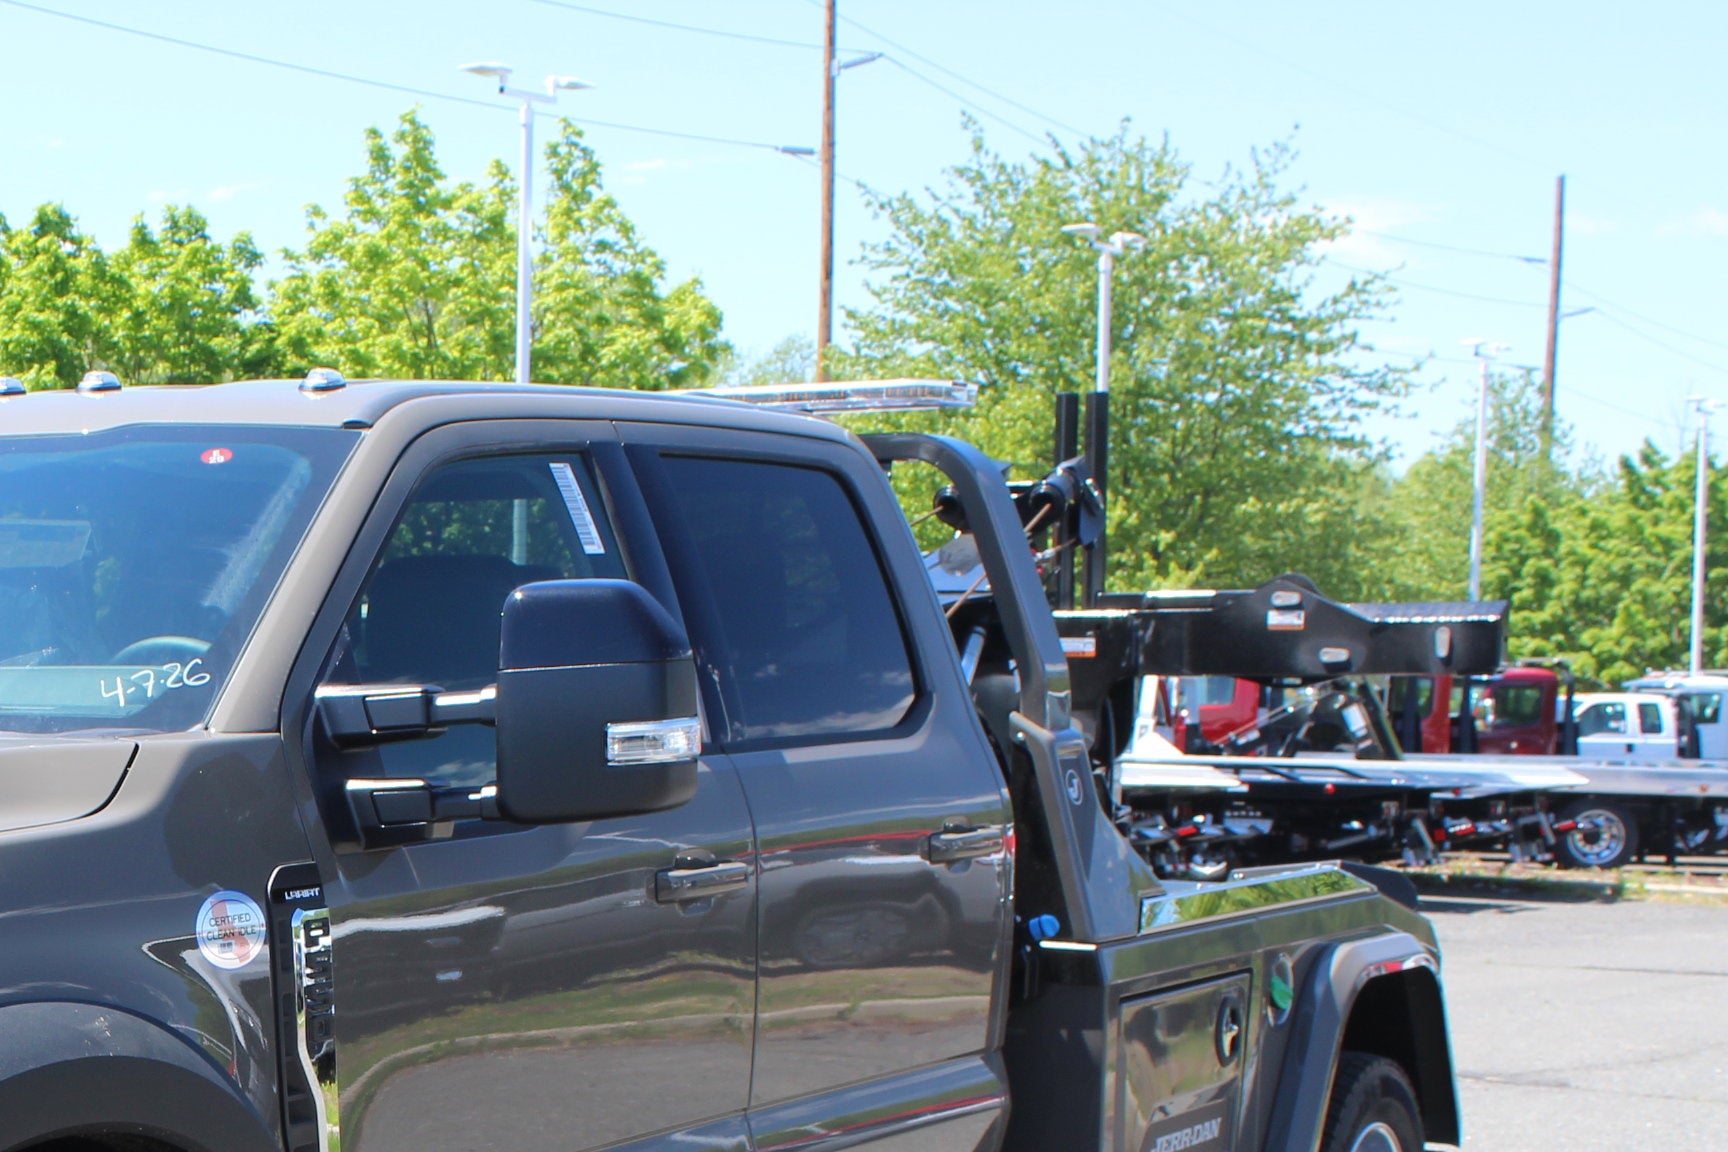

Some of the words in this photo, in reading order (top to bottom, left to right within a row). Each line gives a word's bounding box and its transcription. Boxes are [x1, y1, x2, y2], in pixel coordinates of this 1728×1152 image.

[209, 912, 251, 927] CERTIFIED
[206, 927, 235, 941] CLEAN
[238, 925, 257, 937] IDLE
